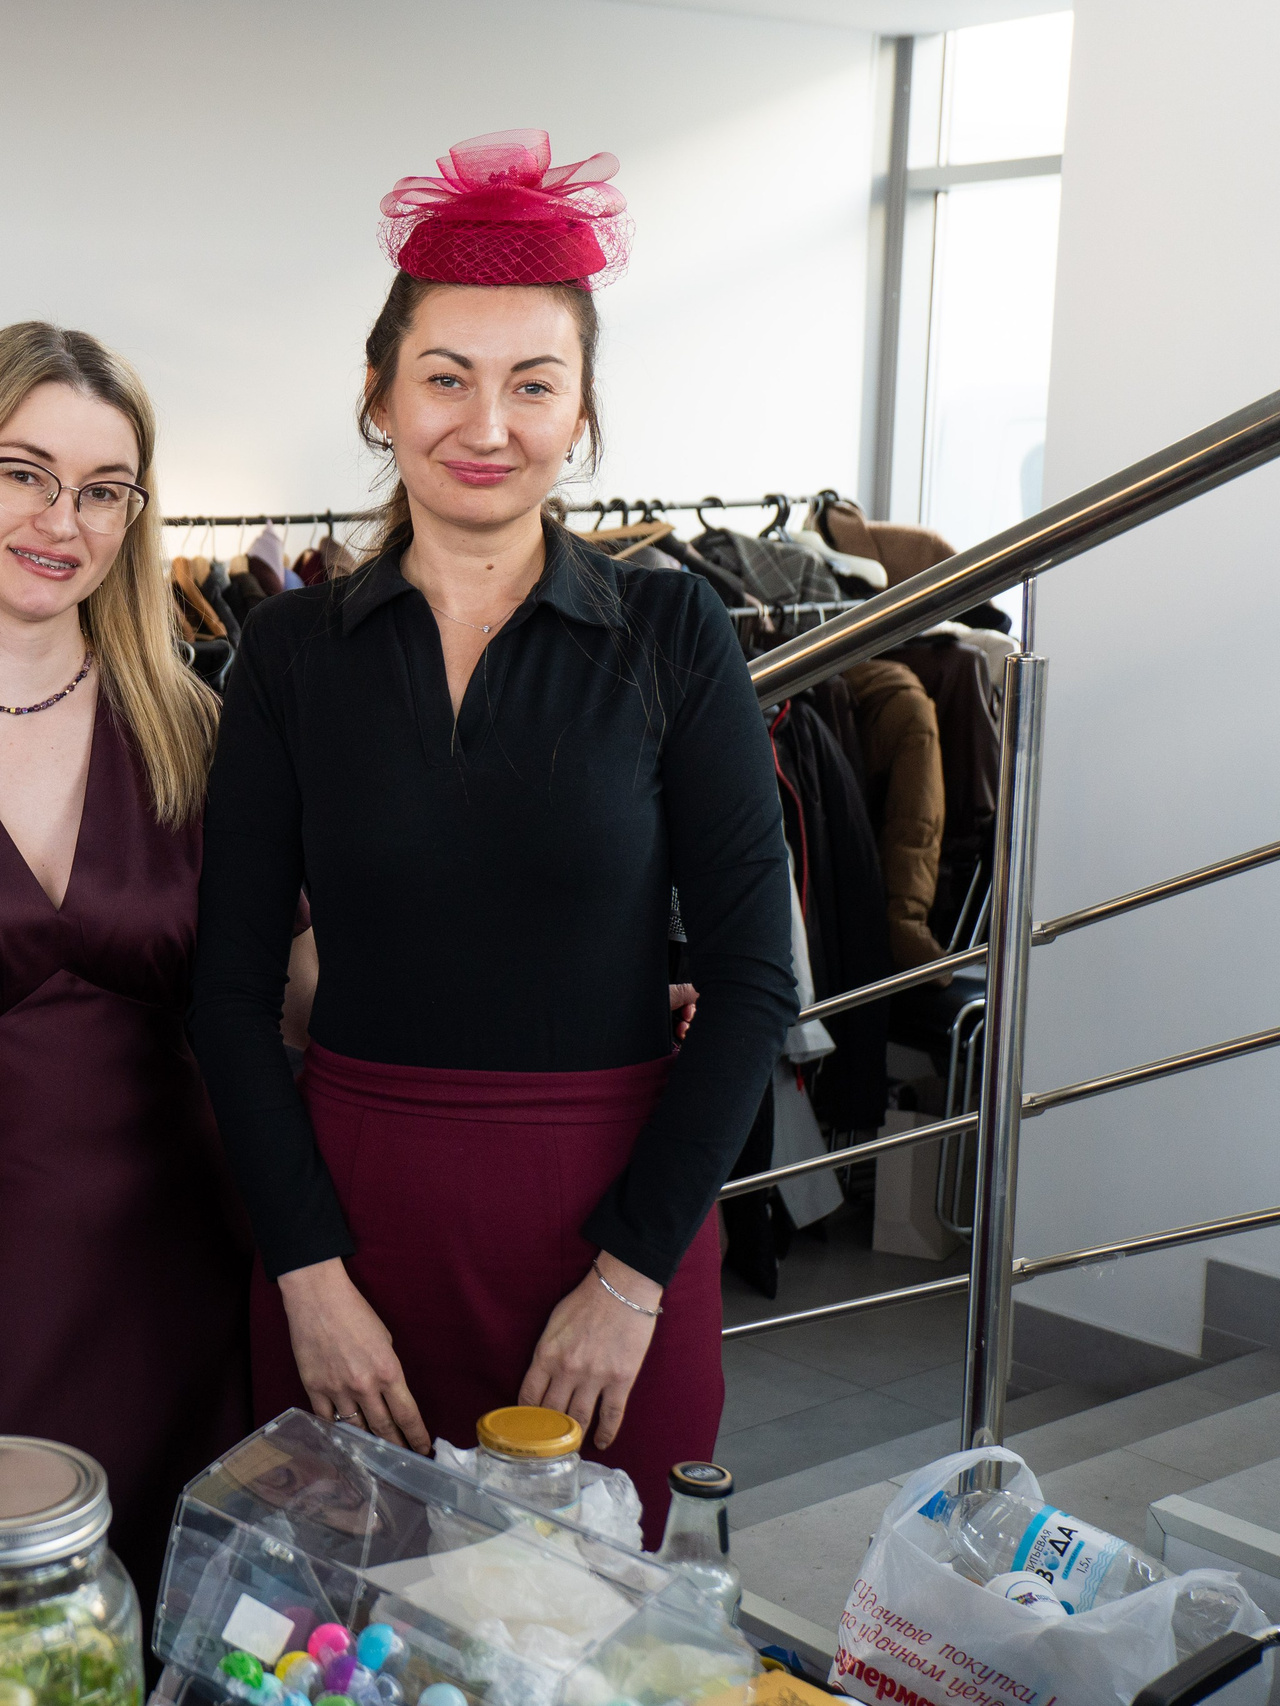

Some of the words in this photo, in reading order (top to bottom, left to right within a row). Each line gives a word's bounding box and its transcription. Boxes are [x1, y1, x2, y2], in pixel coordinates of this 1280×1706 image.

[1076, 1557, 1093, 1574] 1,5л
[852, 1578, 933, 1646] Удачные
[938, 1643, 1038, 1704] покупки
[853, 1623, 946, 1682] удачным
